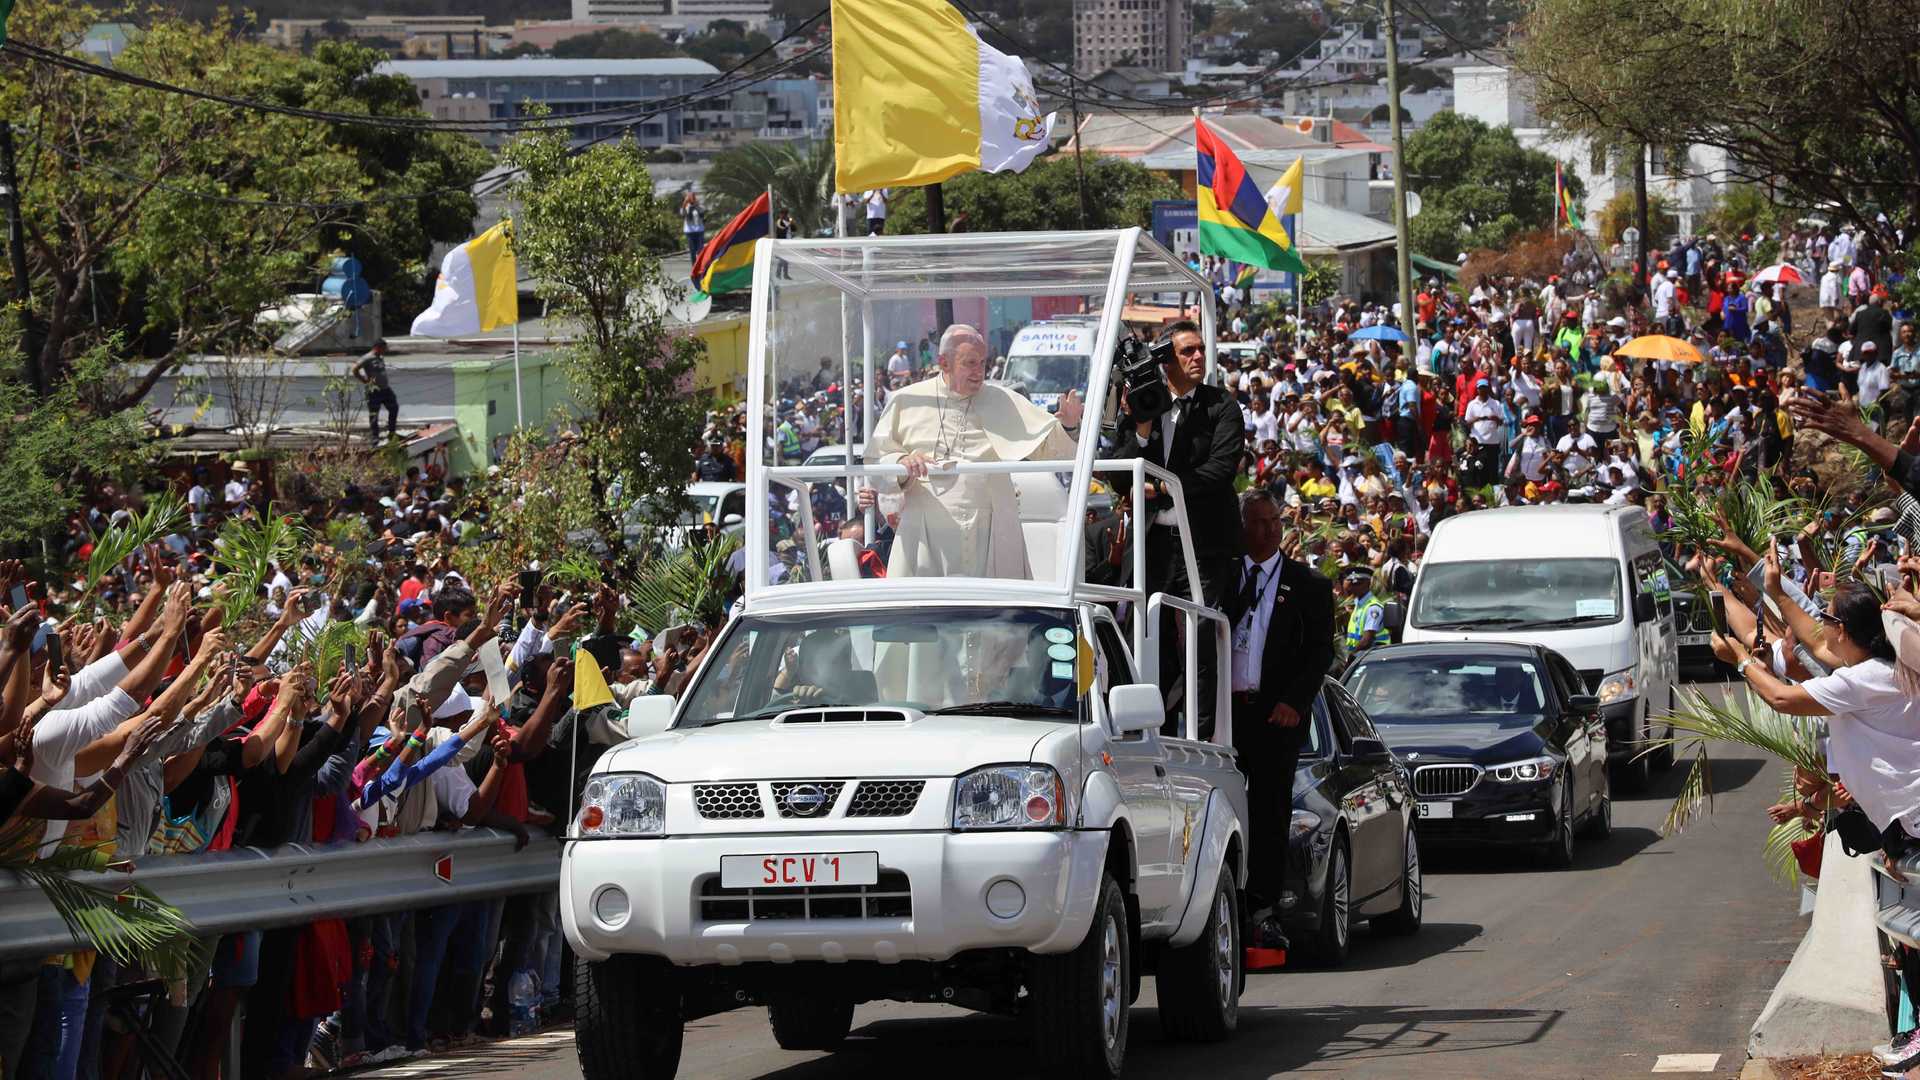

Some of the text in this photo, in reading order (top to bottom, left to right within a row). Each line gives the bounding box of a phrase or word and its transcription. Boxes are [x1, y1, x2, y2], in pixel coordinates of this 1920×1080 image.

[1021, 333, 1065, 342] SAMU
[1055, 343, 1076, 352] 114
[830, 857, 840, 882] 1
